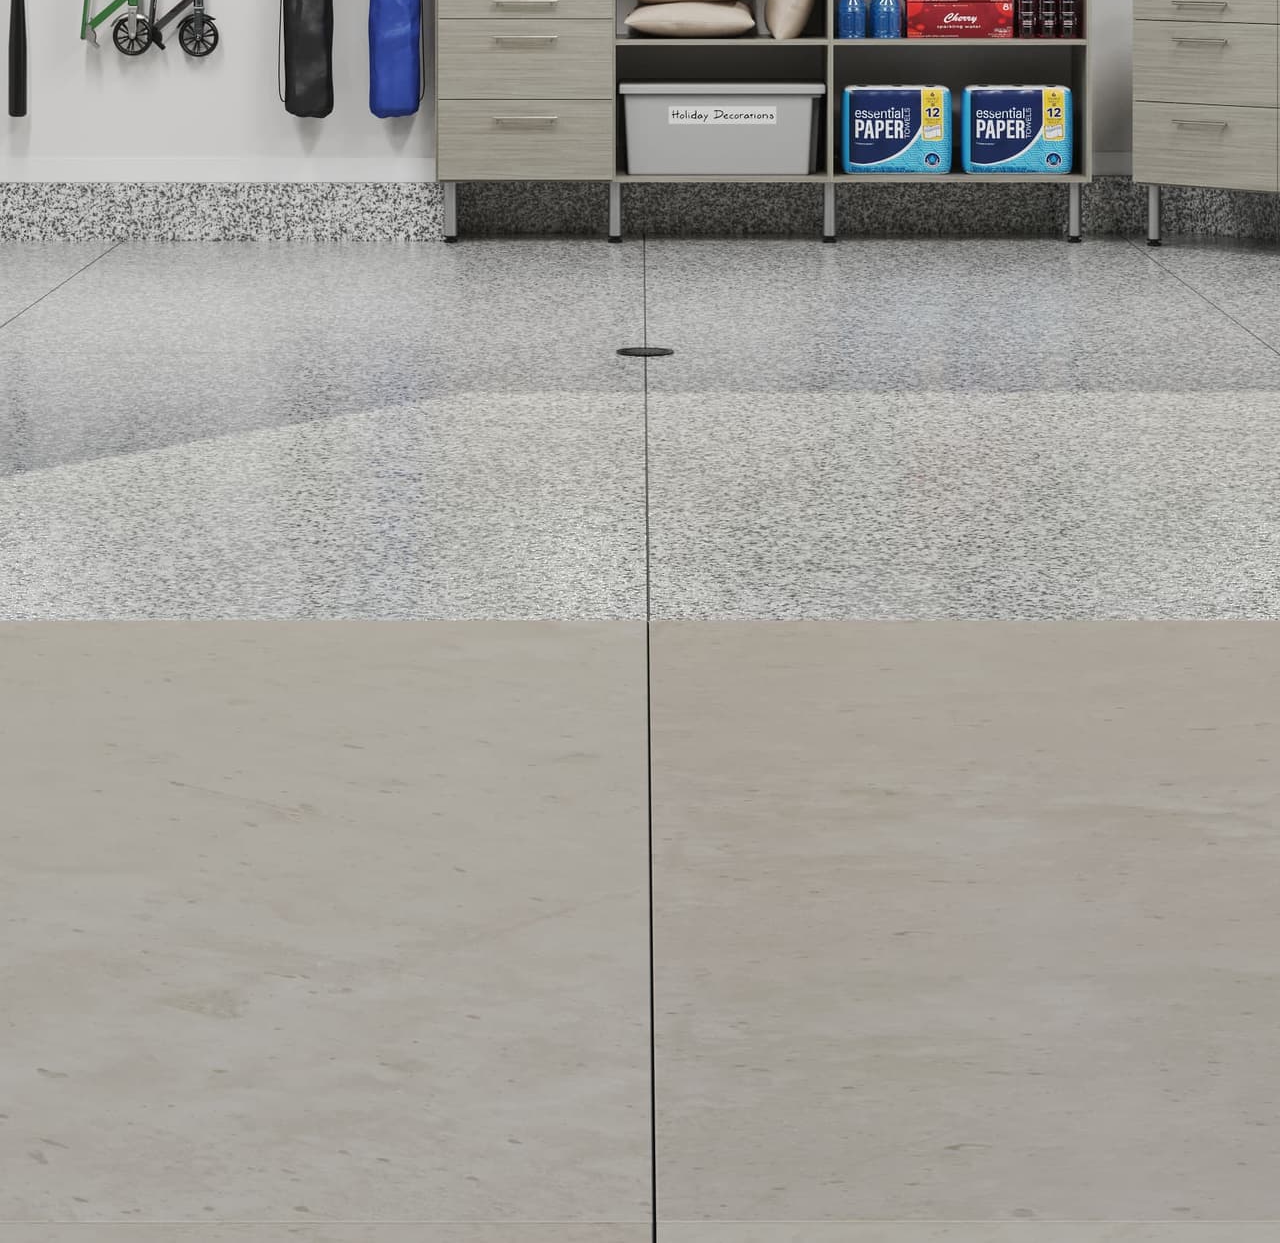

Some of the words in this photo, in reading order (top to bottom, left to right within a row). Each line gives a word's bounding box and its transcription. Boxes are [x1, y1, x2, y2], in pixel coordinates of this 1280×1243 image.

[943, 12, 978, 24] Cherry
[671, 109, 709, 122] Holiday
[713, 109, 775, 120] Decorations
[855, 107, 904, 119] essential
[925, 108, 940, 118] 12
[976, 107, 1026, 119] essential
[1046, 108, 1062, 118] 12
[903, 107, 911, 138] TOWELS
[855, 119, 904, 139] PAPER
[976, 119, 1026, 139] PAPER
